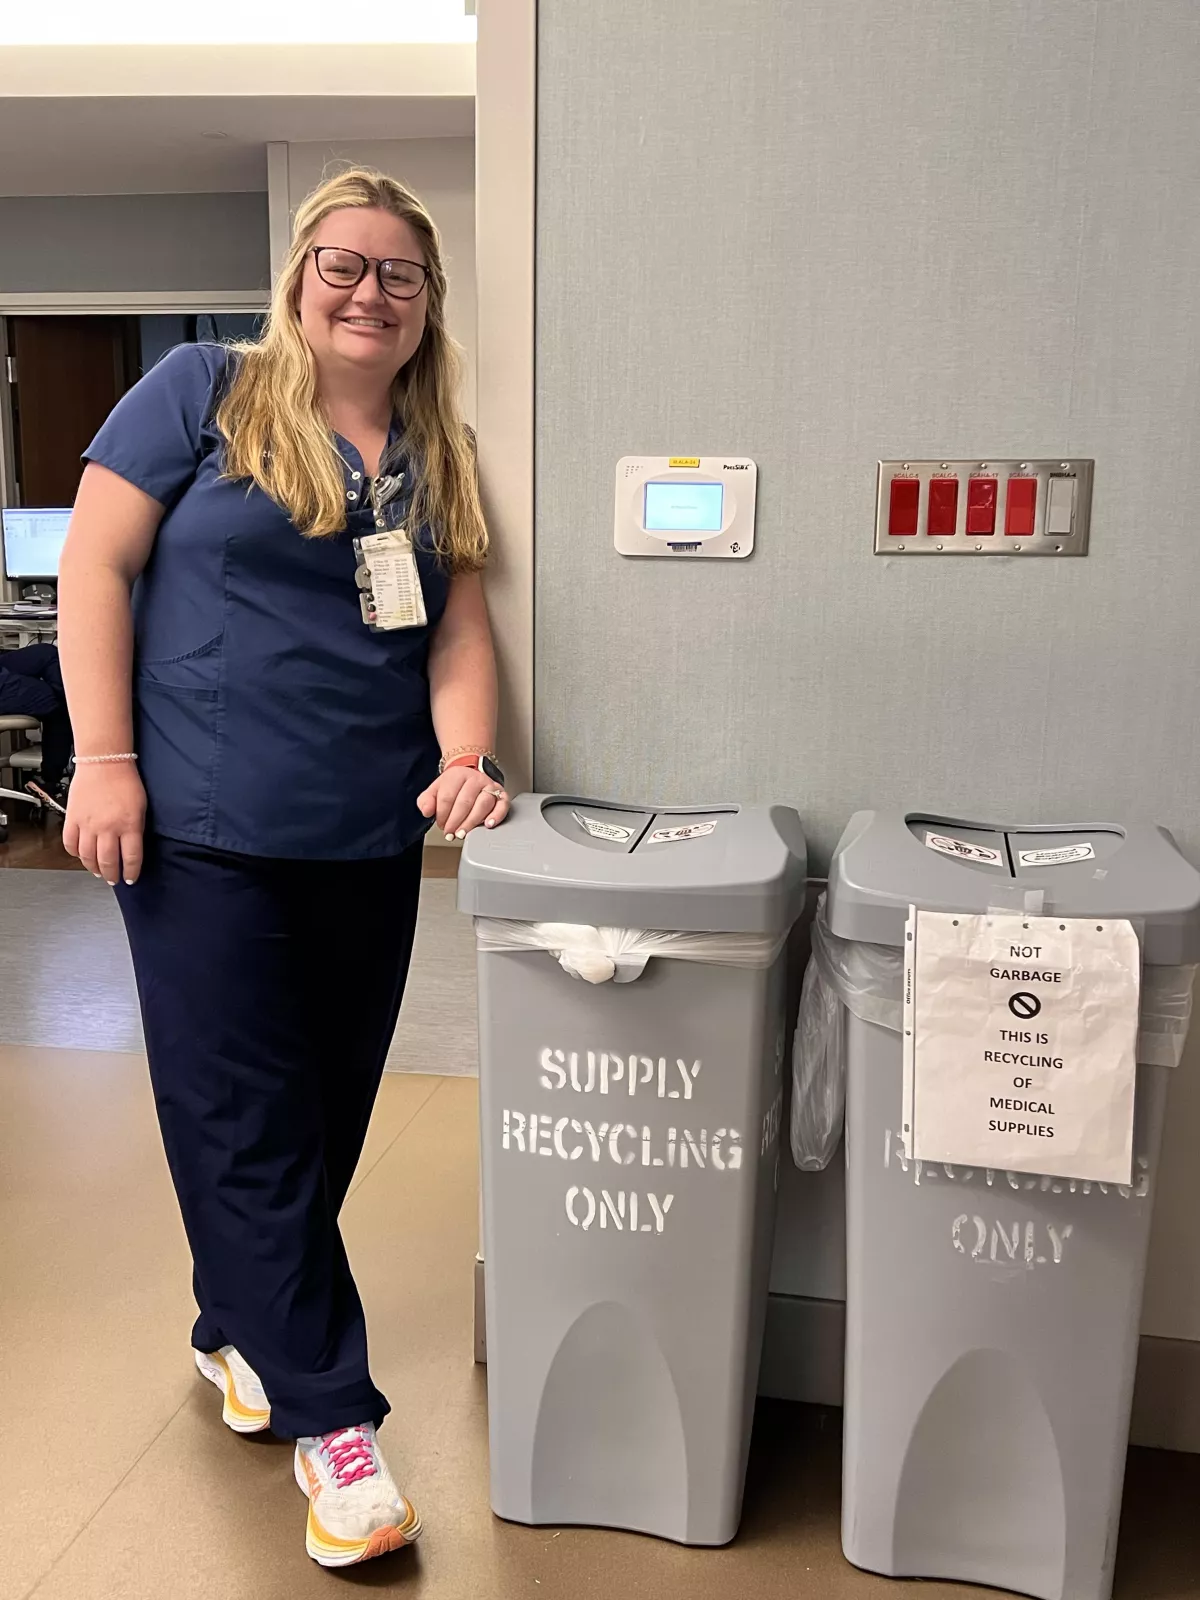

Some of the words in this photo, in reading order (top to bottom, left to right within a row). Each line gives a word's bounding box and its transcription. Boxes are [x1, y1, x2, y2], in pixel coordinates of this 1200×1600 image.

[1009, 945, 1042, 959] NOT
[990, 967, 1062, 984] GARBAGE
[999, 1029, 1032, 1043] THIS
[1036, 1032, 1049, 1045] IS
[984, 1050, 1063, 1069] RECYCLING
[539, 1047, 701, 1099] SUPPLY
[1013, 1076, 1032, 1089] OF
[989, 1097, 1055, 1115] MEDICAL
[988, 1119, 1055, 1138] SUPPLIES
[501, 1108, 744, 1171] RECYCLING
[564, 1185, 675, 1234] ONLY
[951, 1213, 1073, 1264] ONLY
